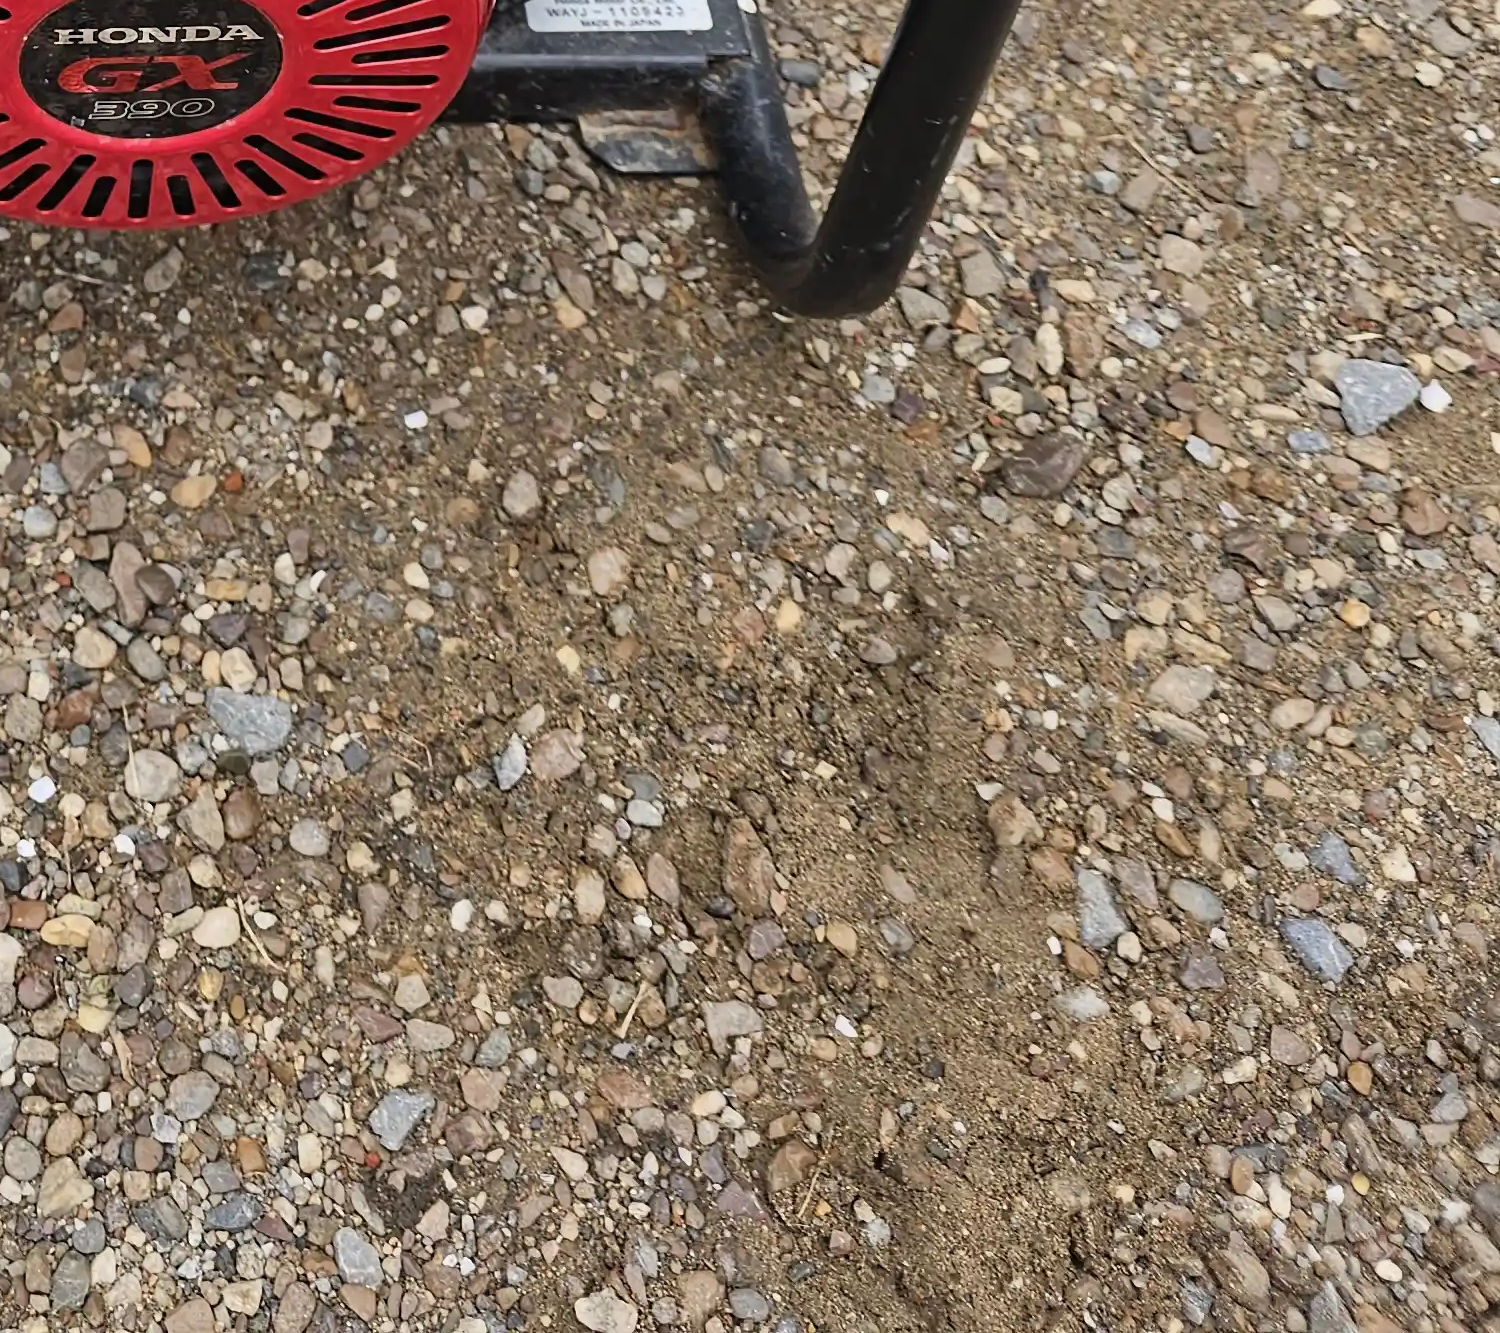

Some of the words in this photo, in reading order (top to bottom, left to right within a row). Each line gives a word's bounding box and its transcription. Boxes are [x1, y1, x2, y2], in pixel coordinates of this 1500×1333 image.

[546, 7, 587, 17] WAYJ
[580, 19, 610, 27] MADE
[614, 19, 625, 27] IN
[628, 19, 662, 27] JAPAN
[54, 25, 264, 45] HONDA
[58, 52, 252, 93] GX
[88, 98, 216, 120] 390
